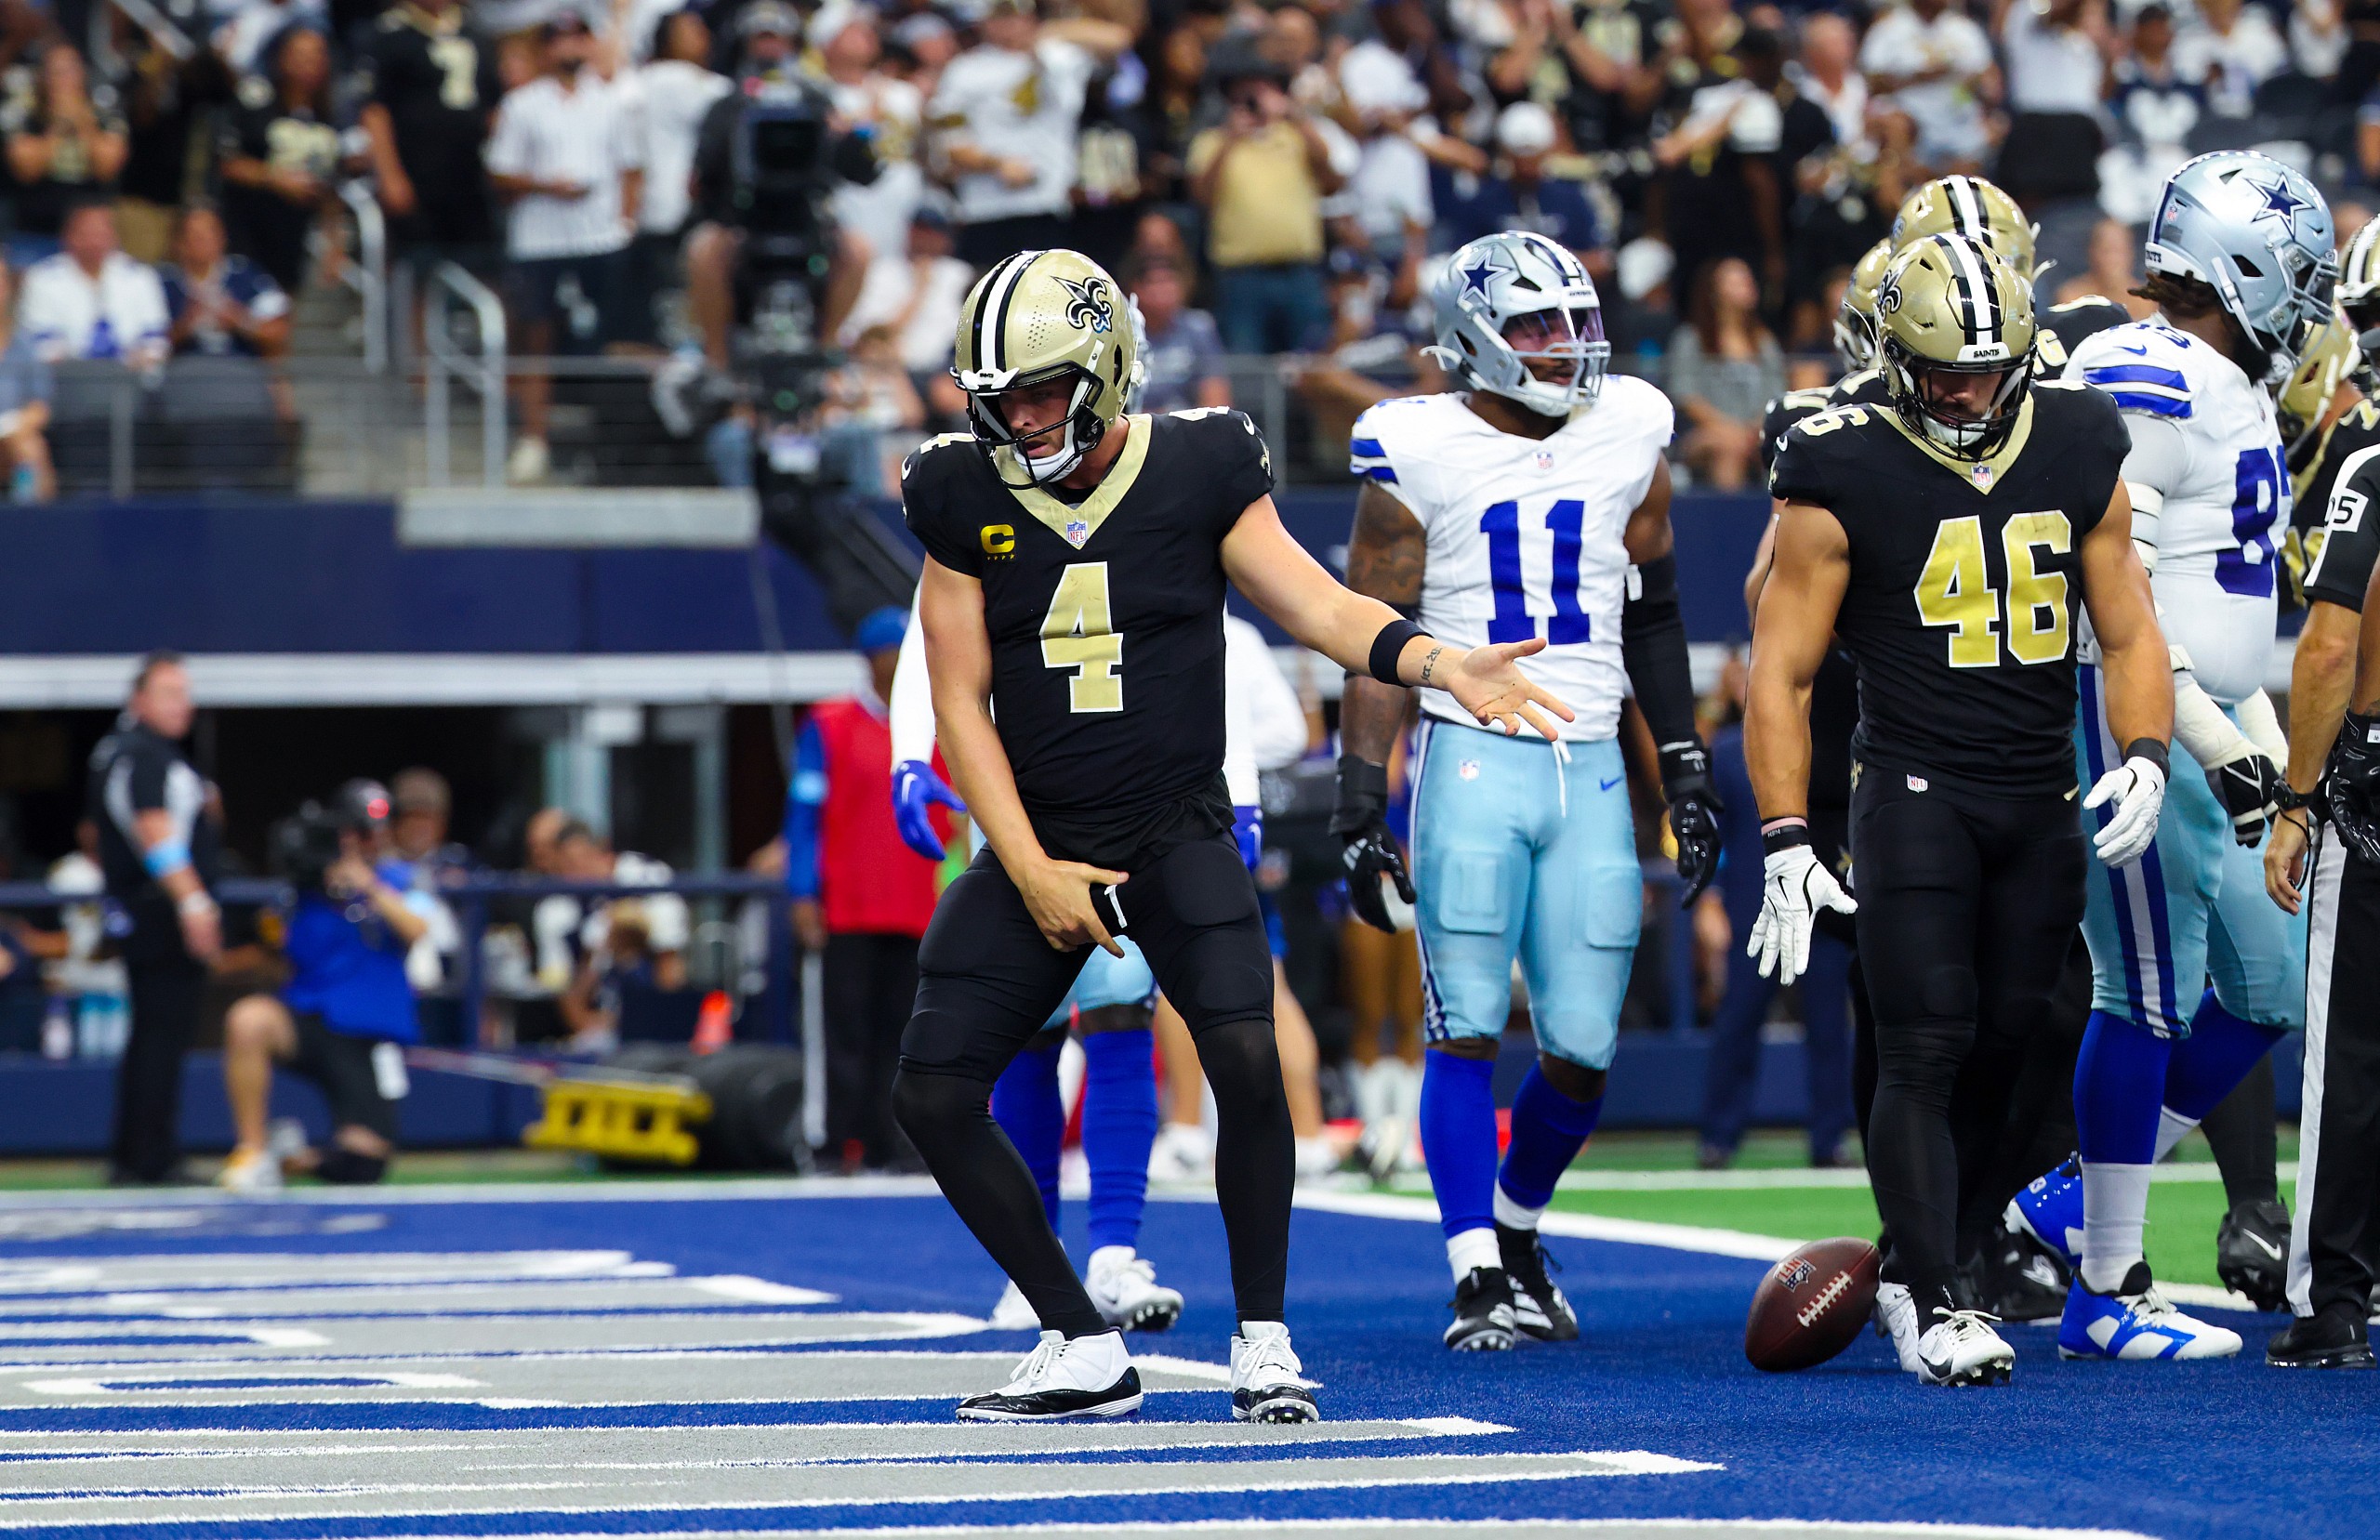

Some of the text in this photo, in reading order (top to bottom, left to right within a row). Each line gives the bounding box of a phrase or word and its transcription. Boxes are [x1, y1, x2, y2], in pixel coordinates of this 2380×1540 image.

[1974, 349, 2000, 358] SAINTS
[981, 524, 1014, 553] C
[1070, 531, 1084, 541] NFL
[1480, 499, 1591, 645] 11
[1913, 509, 2071, 668] 46
[1038, 561, 1123, 713] 4
[1778, 1257, 1802, 1278] NFL
